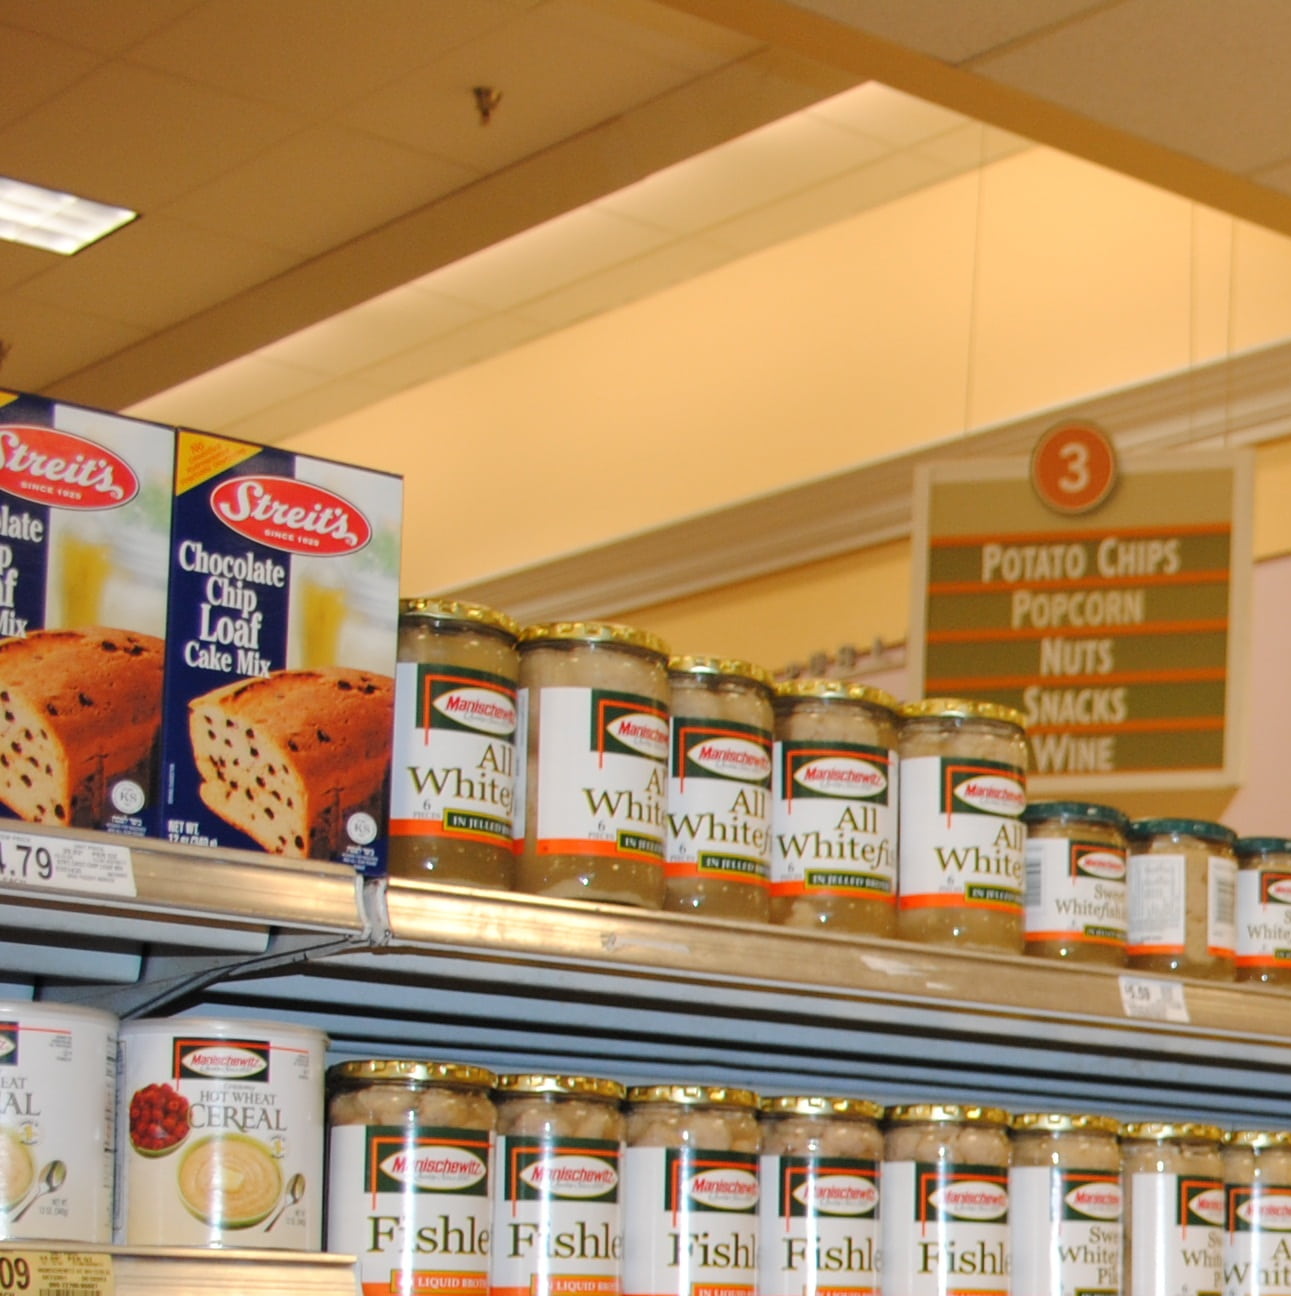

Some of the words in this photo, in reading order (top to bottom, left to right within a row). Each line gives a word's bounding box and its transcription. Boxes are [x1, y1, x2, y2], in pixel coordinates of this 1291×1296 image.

[1058, 443, 1091, 492] 3
[219, 480, 358, 546] Streit's
[178, 540, 285, 589] Chocolate
[981, 543, 1085, 582] POTATO
[1098, 537, 1181, 576] CHIPS
[206, 577, 257, 615] Chip
[1011, 590, 1143, 629] POPCORN
[199, 604, 261, 650] Loaf
[185, 644, 232, 676] Cake
[236, 652, 271, 678] Mix
[1040, 637, 1113, 675] NUTS
[1023, 686, 1126, 726] SNACKS
[477, 743, 513, 776] All
[1032, 735, 1113, 772] WINE
[804, 767, 883, 787] Manischewitz
[728, 789, 766, 820] All
[834, 806, 878, 834] All
[994, 823, 1023, 850] All
[190, 1053, 262, 1071] Manischewitz
[200, 1090, 230, 1103] HOT
[232, 1091, 278, 1106] WHEAT
[188, 1102, 288, 1134] CEREAL
[418, 1277, 459, 1288] LIQUID
[557, 1281, 595, 1291] LIQUID
